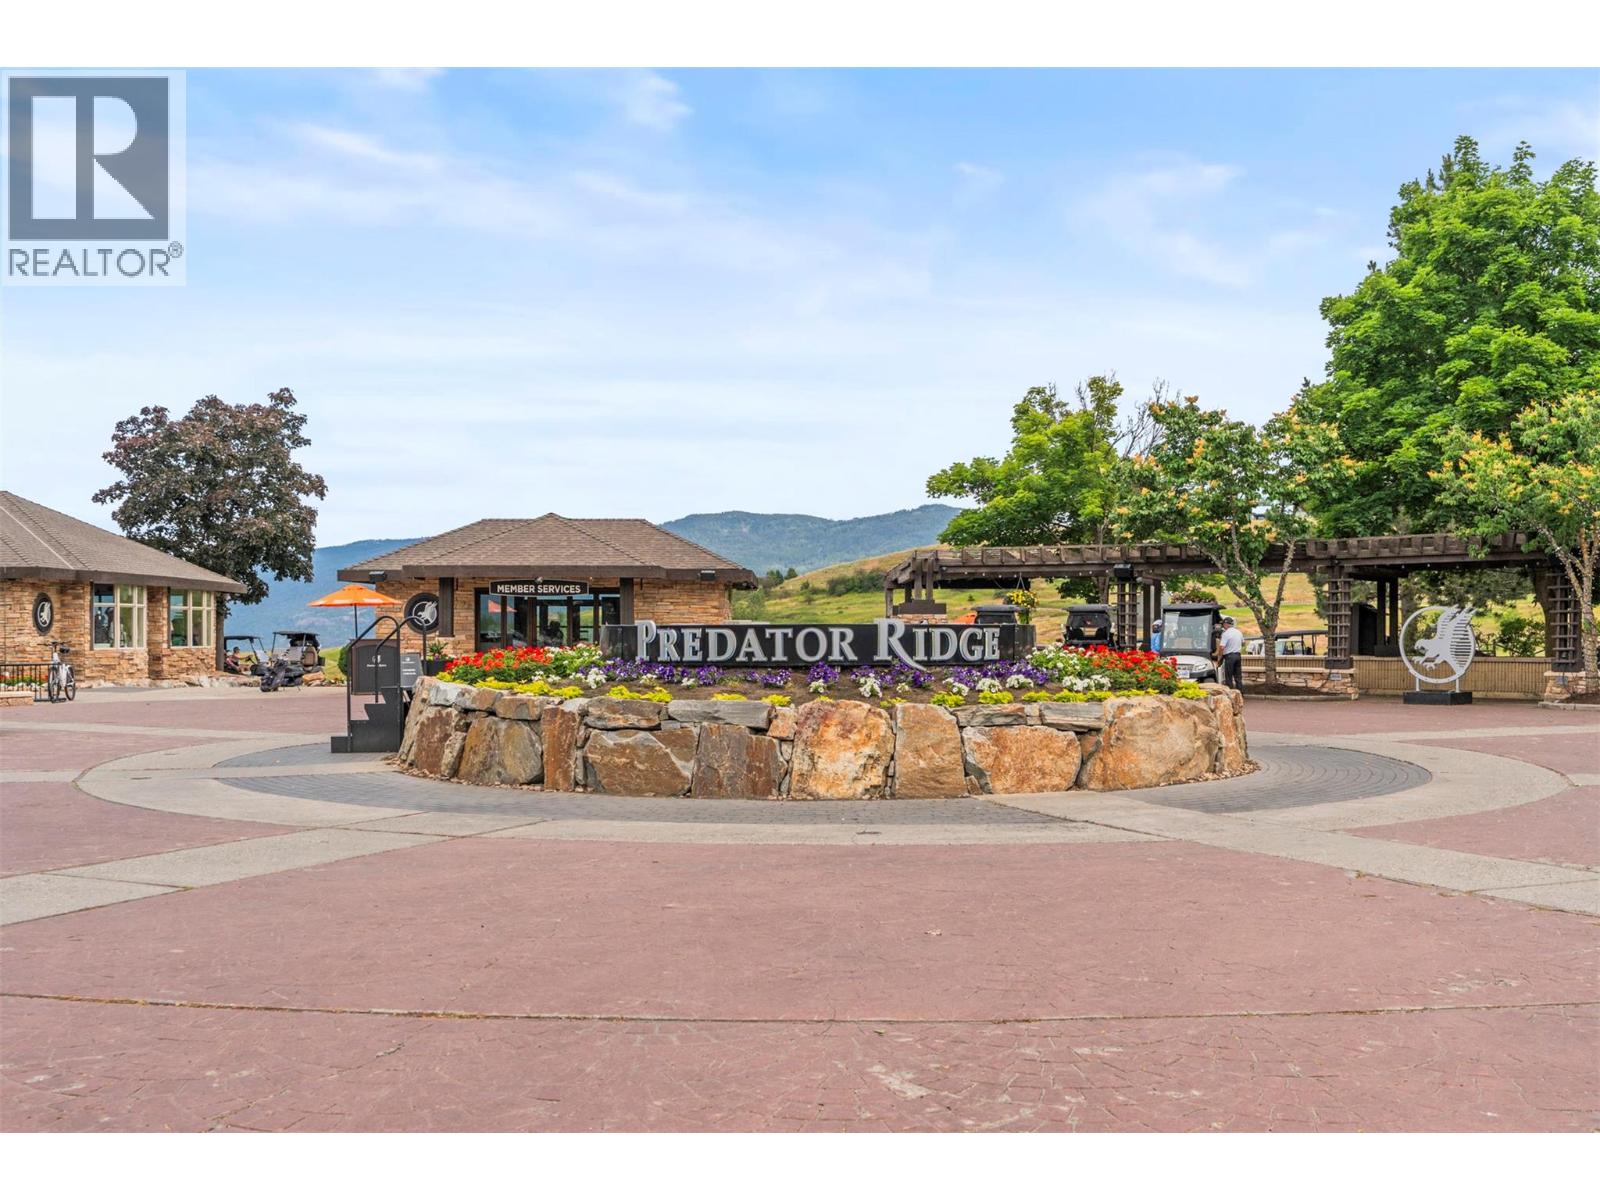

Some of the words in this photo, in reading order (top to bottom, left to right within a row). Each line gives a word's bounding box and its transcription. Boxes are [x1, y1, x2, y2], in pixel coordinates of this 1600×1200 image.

[497, 584, 535, 593] MEMBER
[537, 584, 581, 593] SERVICES
[635, 619, 858, 662] PREDATOR
[873, 618, 1001, 671] RIDGE
